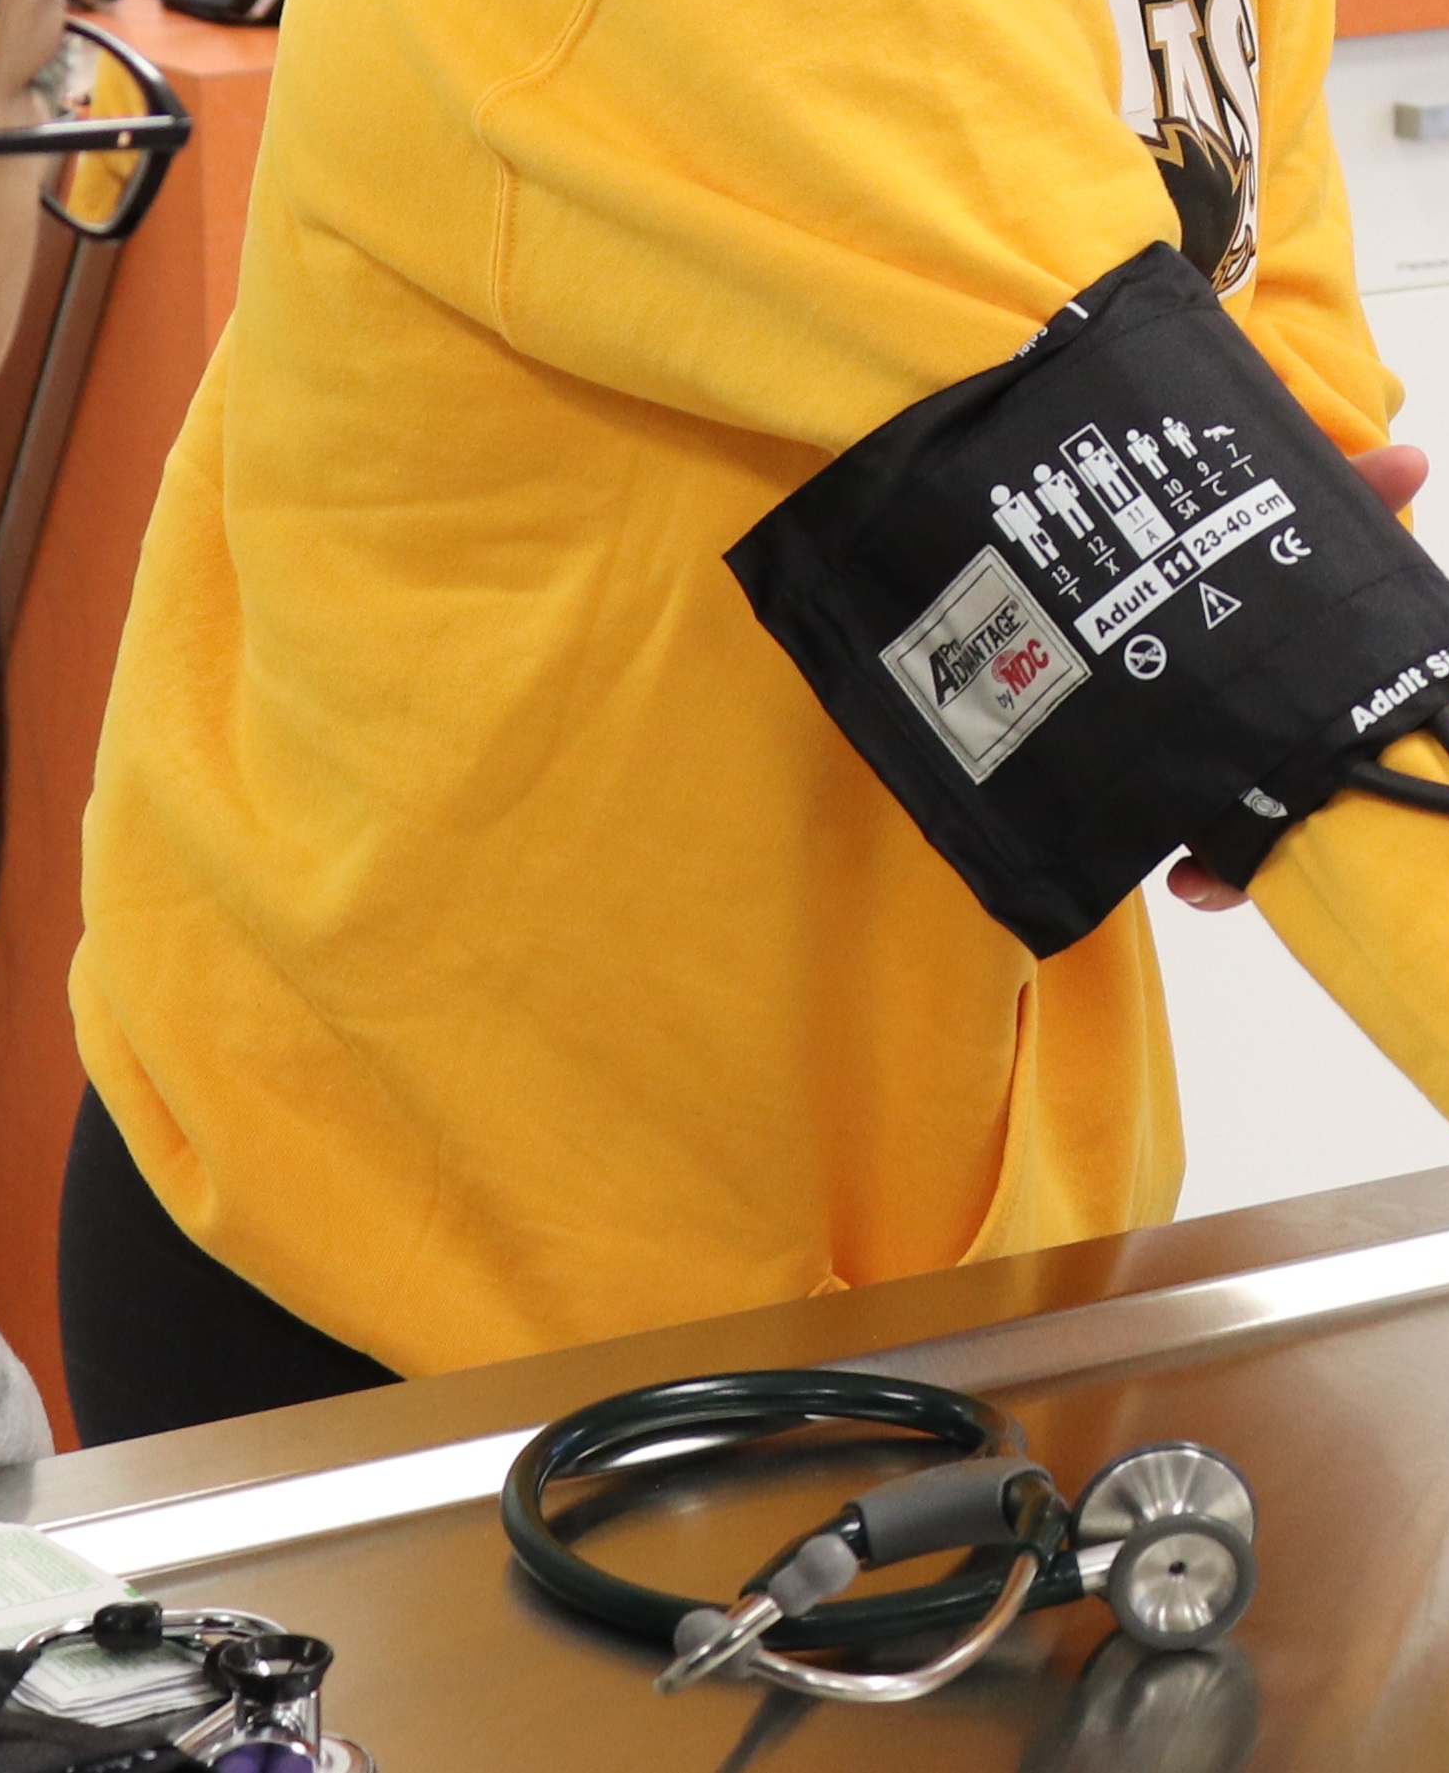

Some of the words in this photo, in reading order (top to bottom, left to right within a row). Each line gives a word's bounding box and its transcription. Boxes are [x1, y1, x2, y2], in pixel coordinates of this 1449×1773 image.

[1051, 564, 1071, 585] 13
[1086, 536, 1109, 557] 12
[1126, 506, 1146, 526] 11
[1162, 478, 1184, 498] 10
[1196, 461, 1210, 477] 9
[1226, 444, 1238, 458] 7
[1066, 589, 1083, 605] T
[1105, 558, 1121, 577] X
[1147, 530, 1161, 545] A
[1177, 500, 1201, 521] SA
[1212, 483, 1228, 498] C
[1095, 578, 1159, 639] Adult
[1163, 549, 1193, 580] 11
[1193, 510, 1253, 557] 23-40
[1255, 494, 1286, 518] cm
[940, 639, 962, 664] Pro
[1002, 639, 1050, 695] NDC
[996, 688, 1016, 711] by
[1350, 666, 1430, 735] Adult
